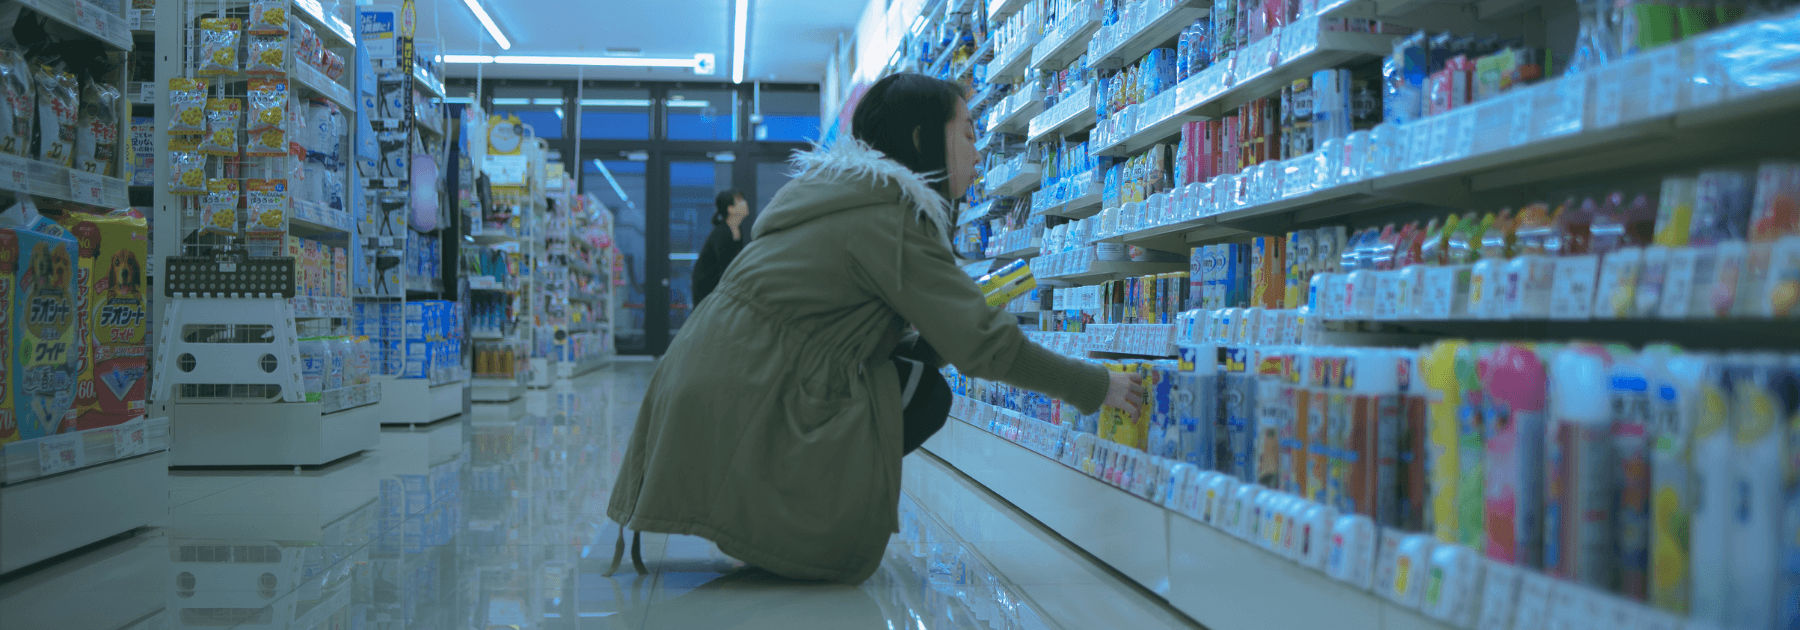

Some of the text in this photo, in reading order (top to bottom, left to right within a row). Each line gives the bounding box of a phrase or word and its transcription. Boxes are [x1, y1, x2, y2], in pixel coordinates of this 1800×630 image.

[31, 297, 70, 324] デオシート
[100, 305, 145, 325] デオシート
[110, 327, 135, 342] ワイド
[35, 342, 66, 362] ワイド
